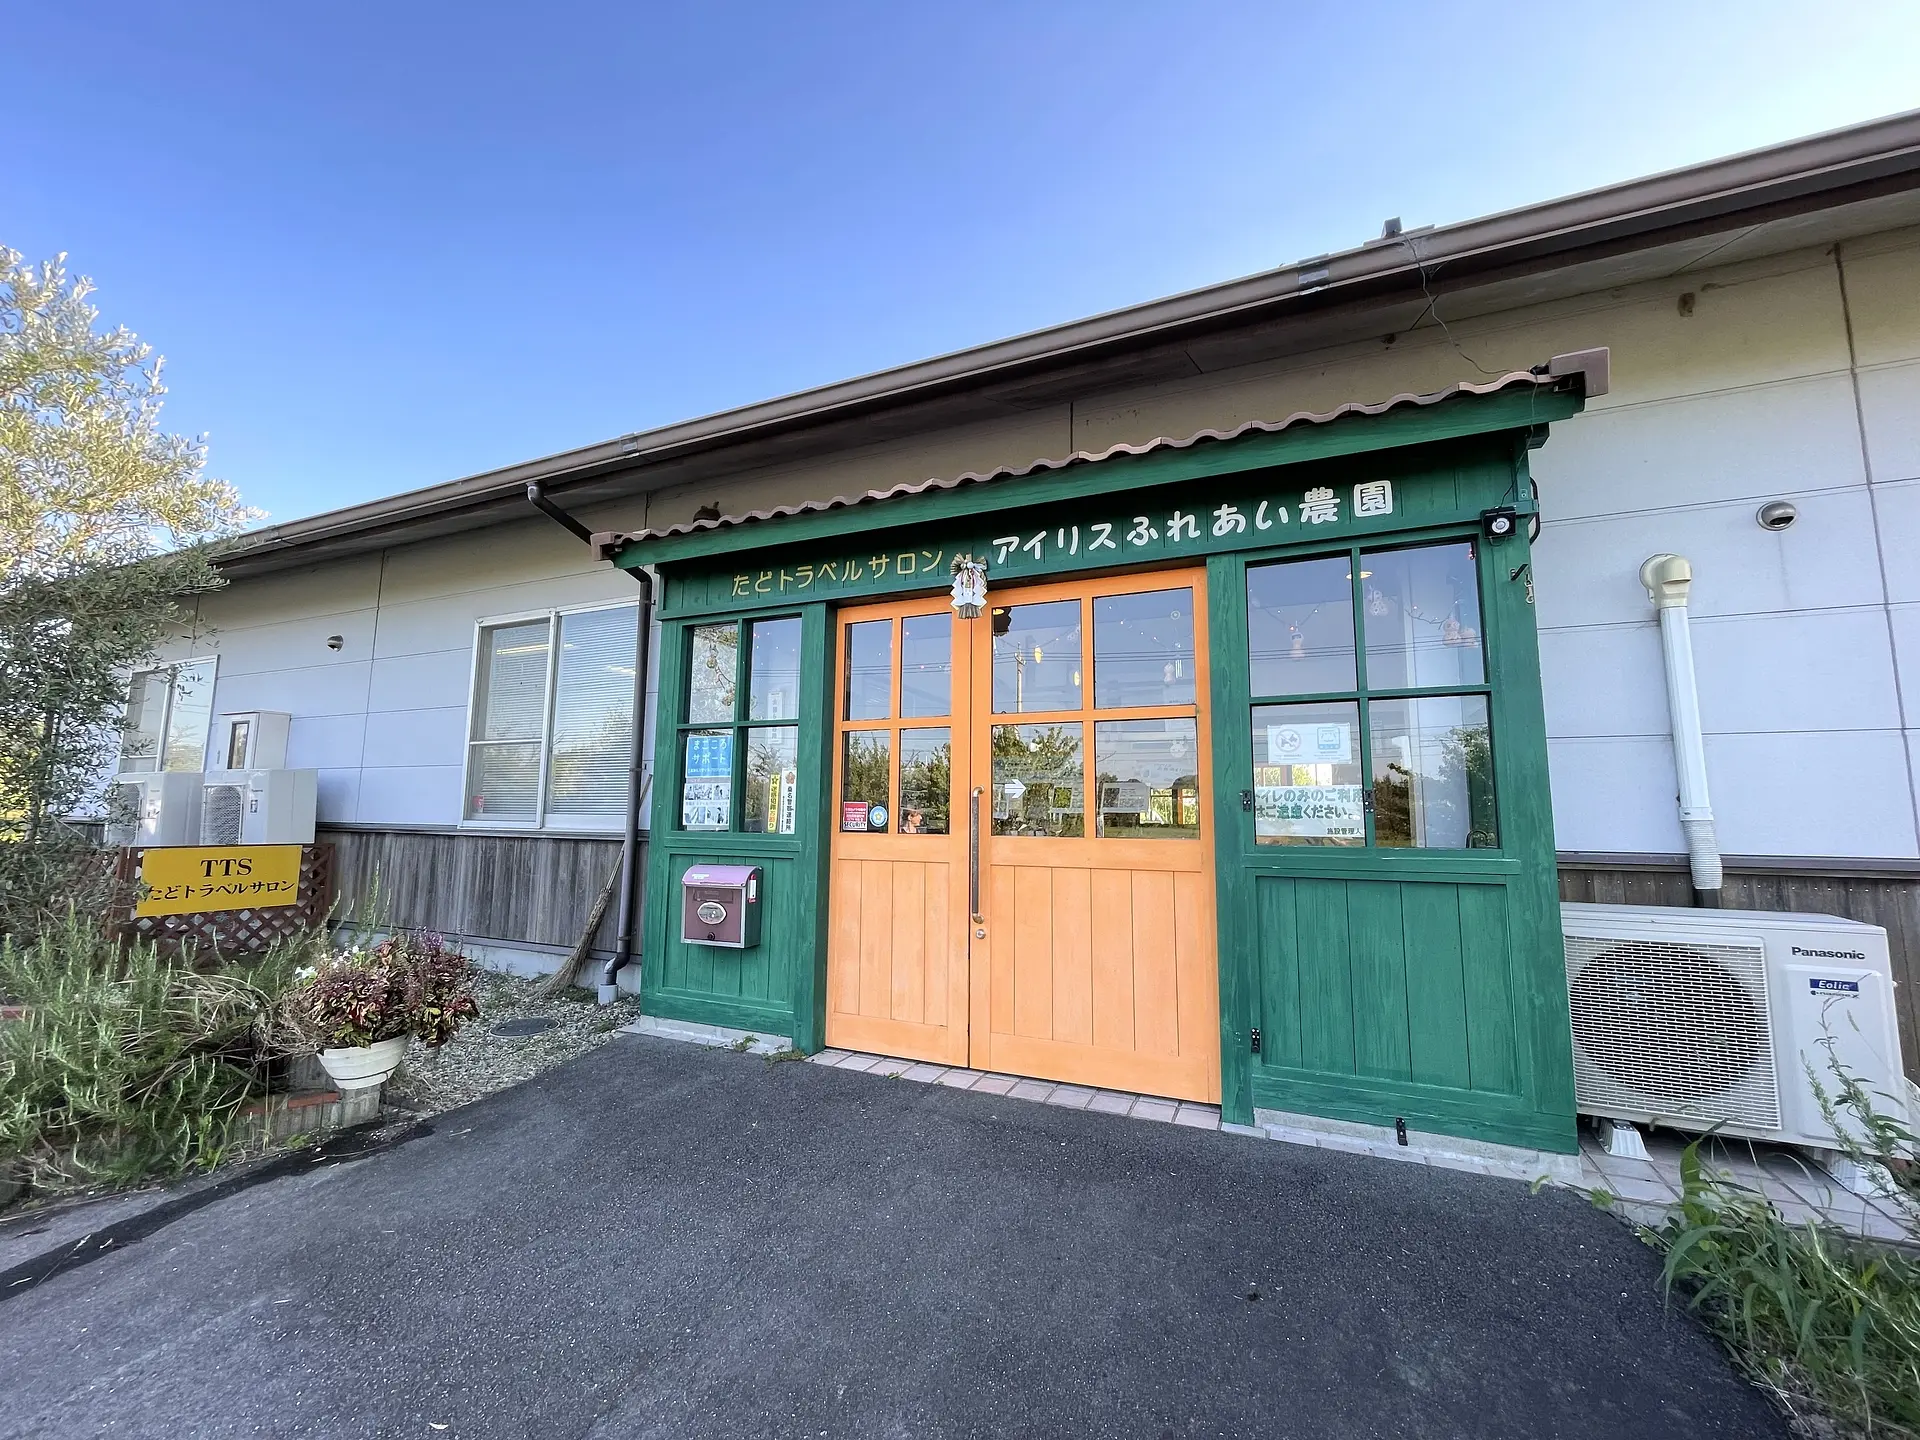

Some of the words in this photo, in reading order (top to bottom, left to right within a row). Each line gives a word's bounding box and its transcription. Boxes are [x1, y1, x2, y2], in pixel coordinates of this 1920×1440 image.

[992, 480, 1394, 564] アイリスふれあい農園
[731, 550, 943, 597] たどトラベルサロン
[693, 738, 728, 751] まごころ
[691, 752, 727, 765] サポート
[1326, 827, 1362, 835] 施設管理人
[200, 858, 253, 878] TTS
[1791, 946, 1866, 960] Panasonic
